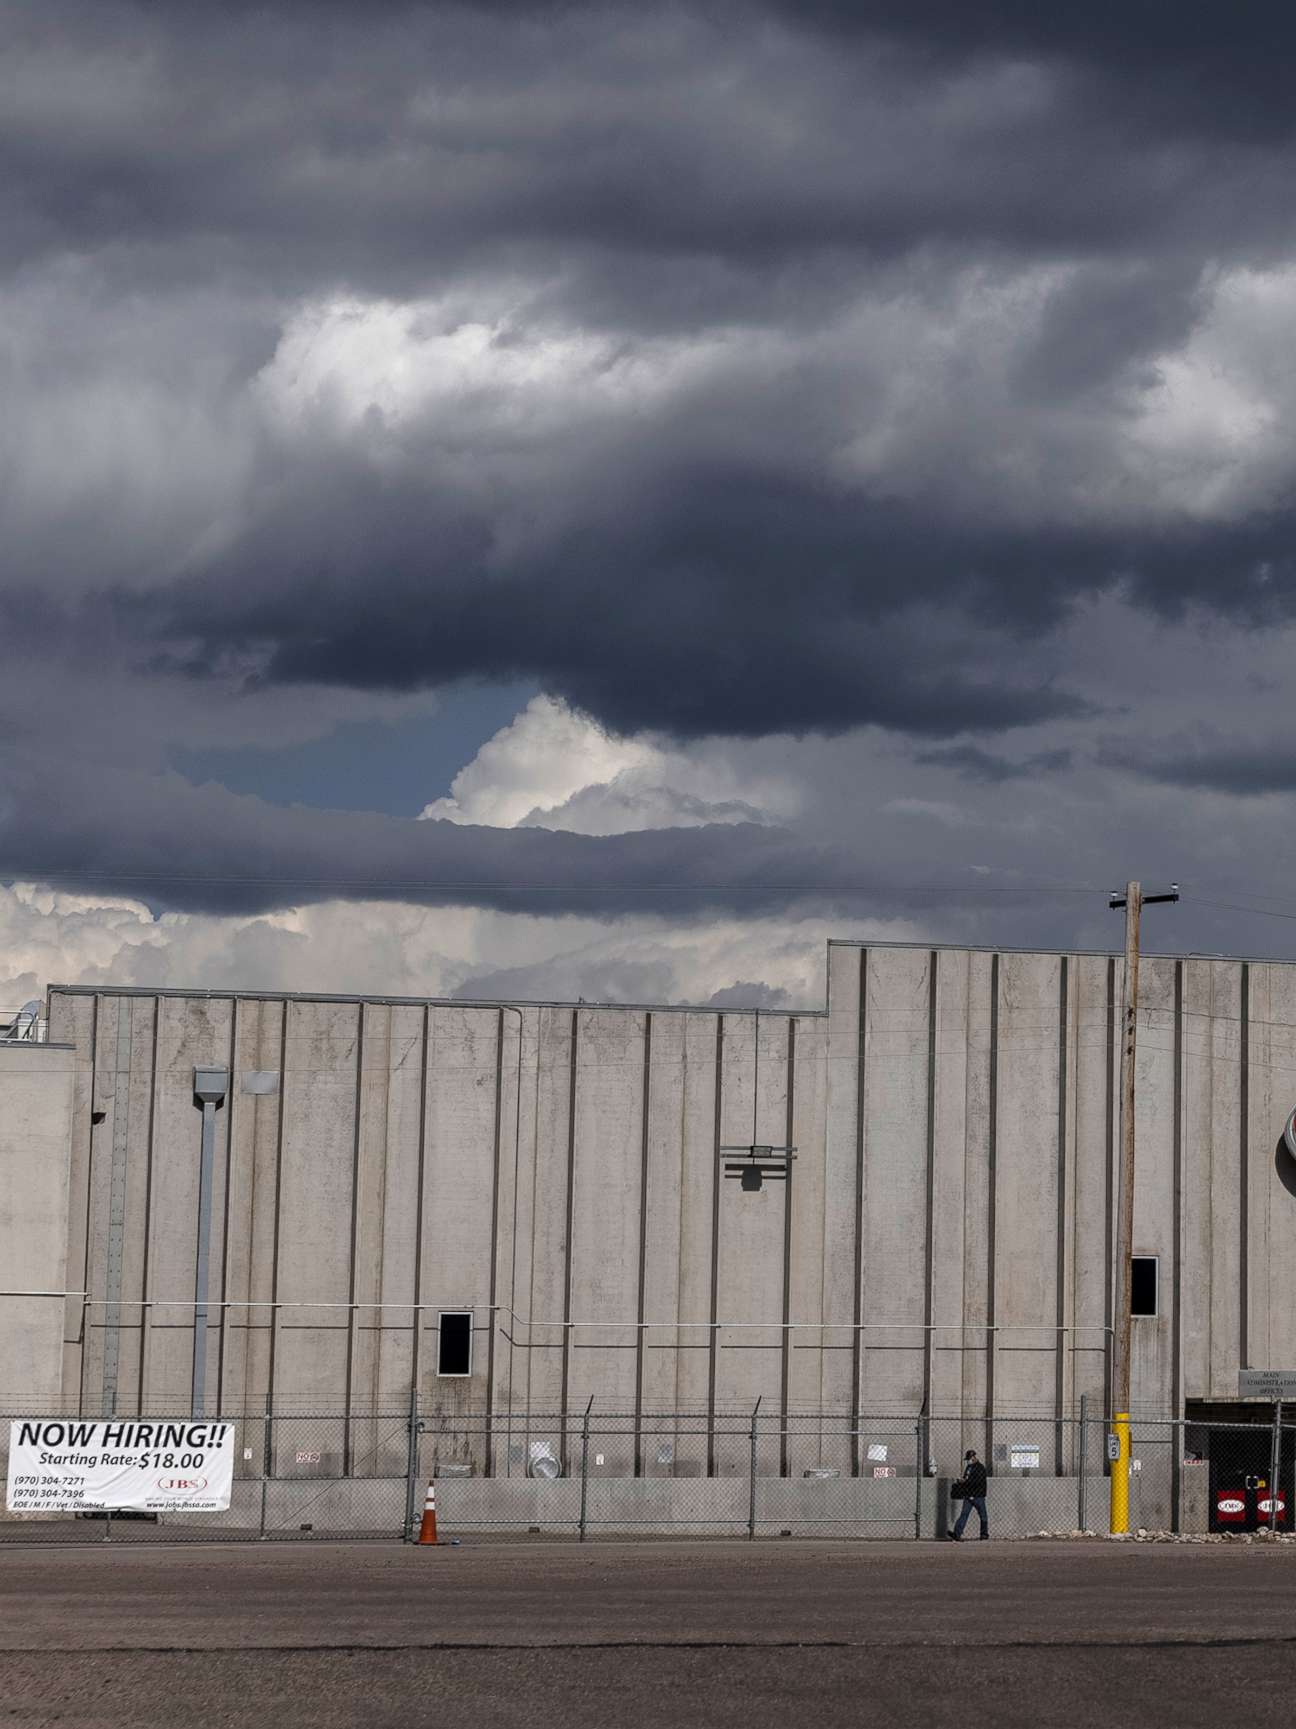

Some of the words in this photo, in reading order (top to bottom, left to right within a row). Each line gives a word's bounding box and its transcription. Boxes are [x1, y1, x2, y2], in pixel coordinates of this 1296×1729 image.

[18, 1422, 97, 1447] NOW
[101, 1424, 227, 1448] HIRING!!
[1112, 1447, 1117, 1456] 5
[39, 1452, 97, 1468] Starting
[14, 1476, 39, 1486] (970)
[41, 1476, 85, 1485] 304-7271
[165, 1479, 199, 1489] JBS
[13, 1489, 39, 1498] (970)
[40, 1489, 85, 1498] 304-7396
